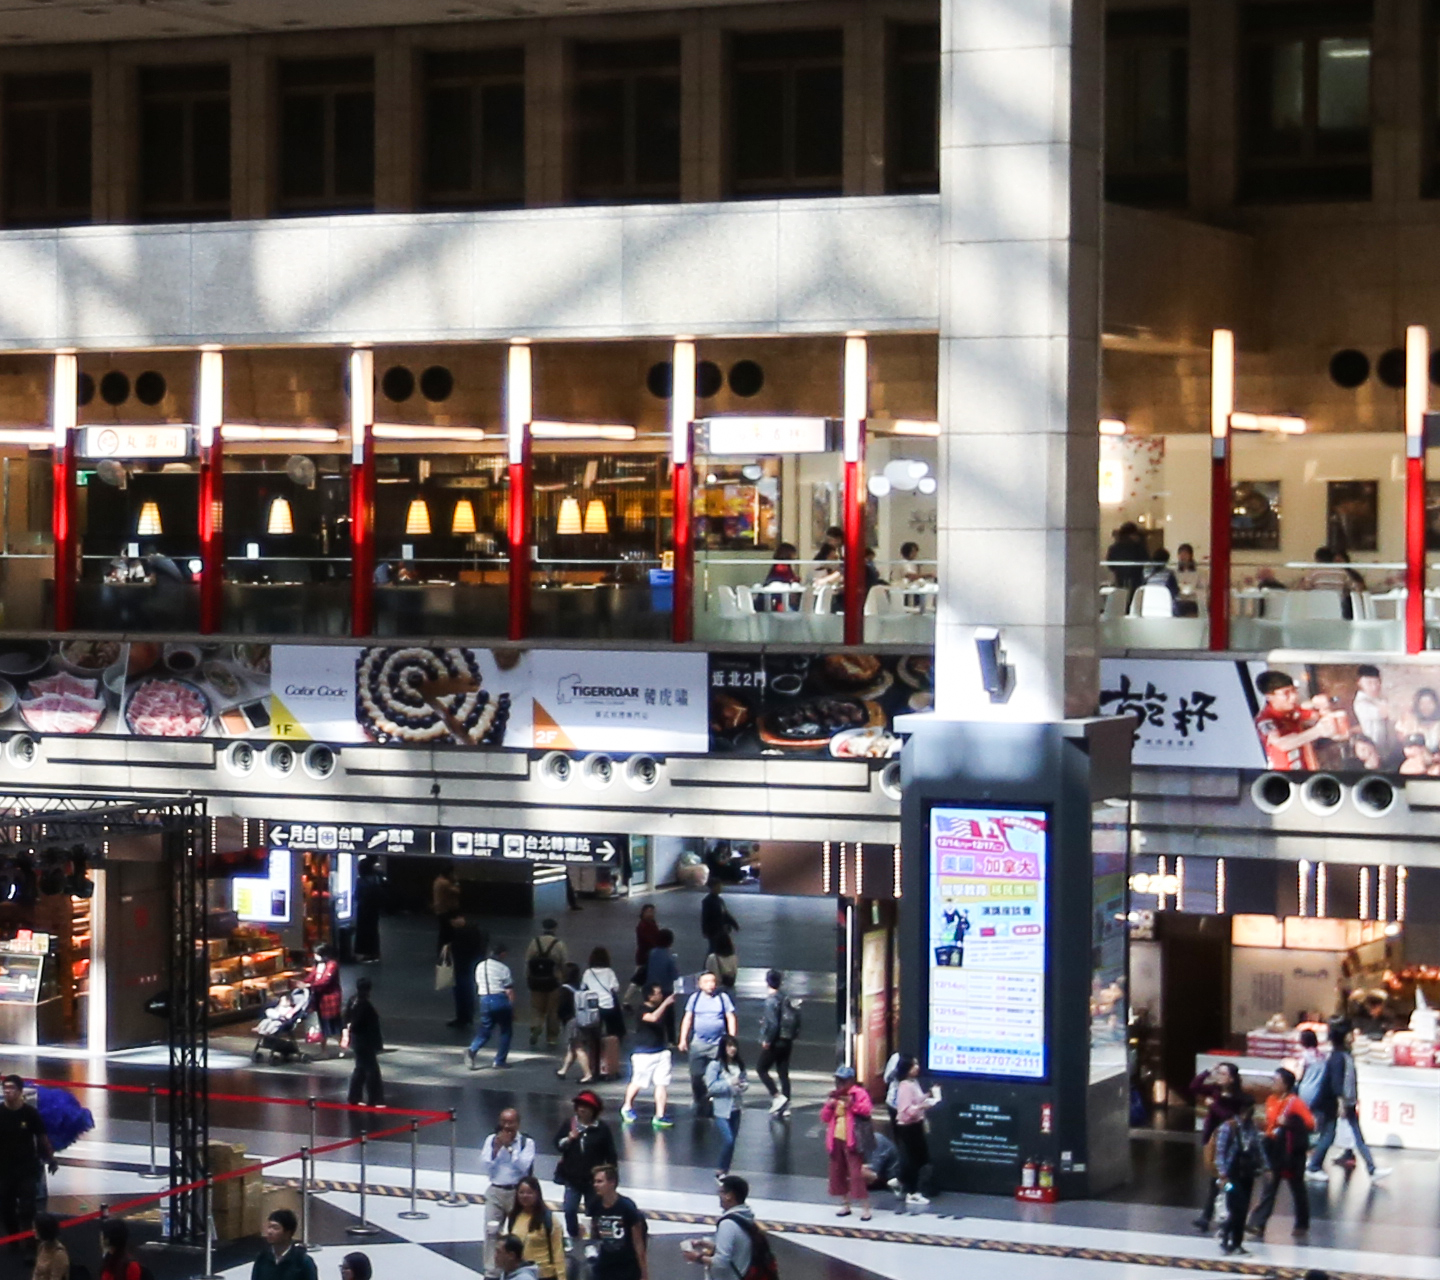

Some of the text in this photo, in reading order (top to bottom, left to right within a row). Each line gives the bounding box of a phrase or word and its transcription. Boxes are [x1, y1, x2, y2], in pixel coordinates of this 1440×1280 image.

[712, 670, 768, 688] 近北2門
[572, 685, 639, 698] TIGERROAR
[275, 724, 293, 736] 1F
[535, 730, 557, 744] 2F
[289, 825, 591, 852] 月台 台鐵 高鐵 捷運 台北轉運站
[338, 842, 355, 850] TRA
[473, 848, 492, 857] MRT
[525, 851, 547, 861] Taipei
[548, 852, 564, 860] Bus
[565, 853, 594, 862] Station
